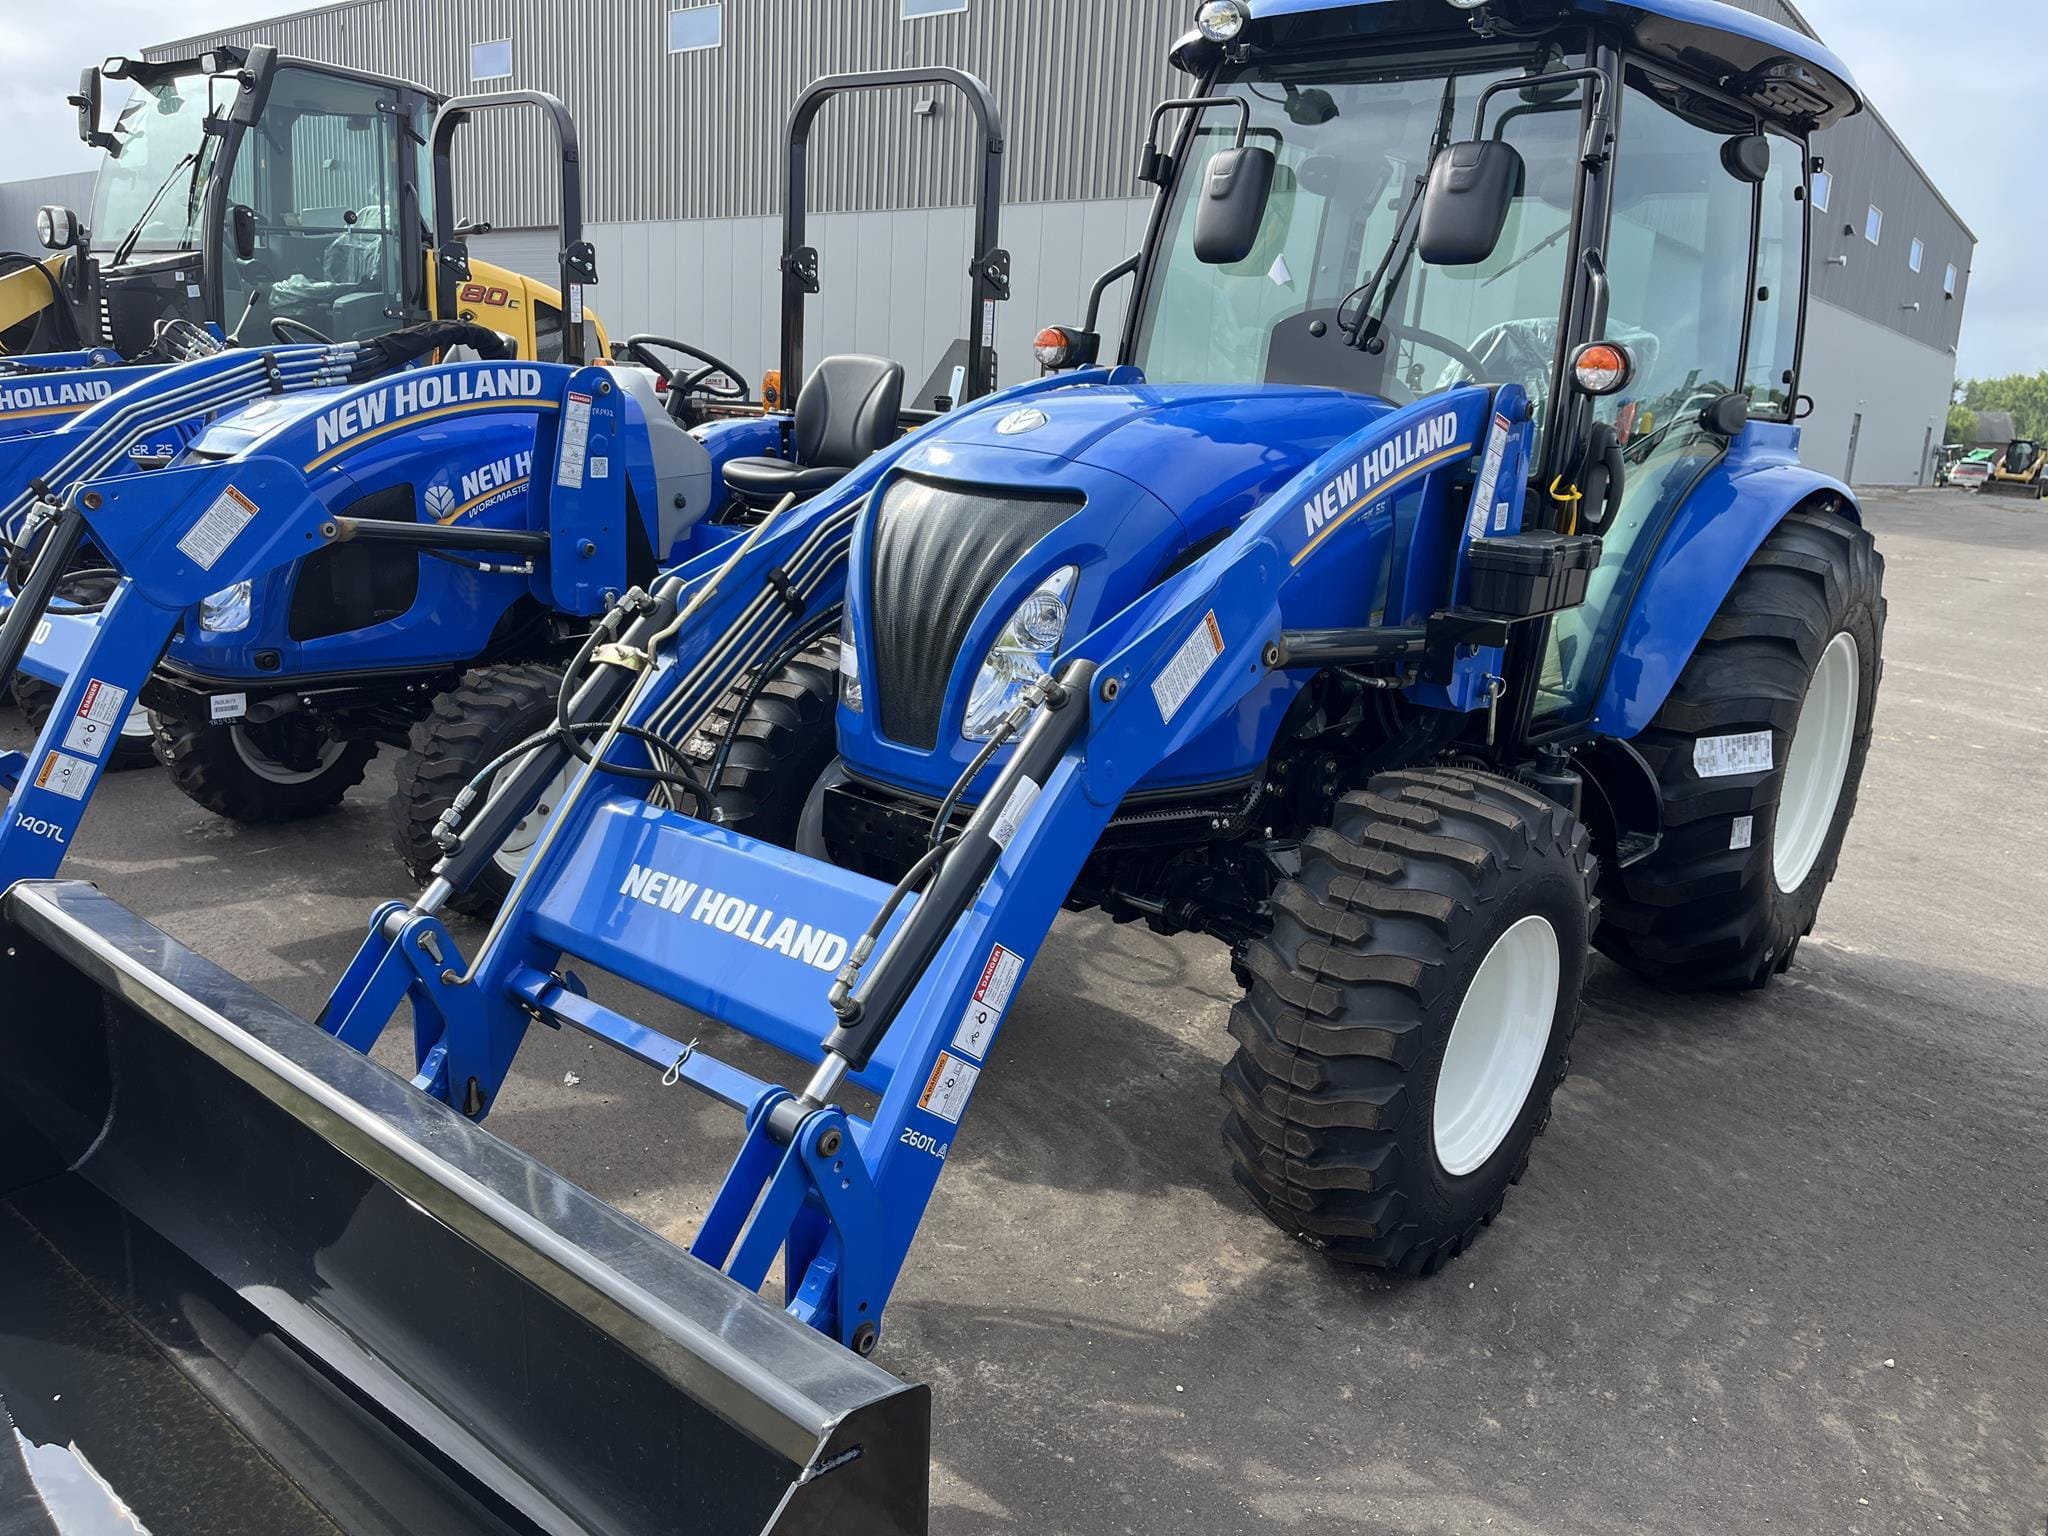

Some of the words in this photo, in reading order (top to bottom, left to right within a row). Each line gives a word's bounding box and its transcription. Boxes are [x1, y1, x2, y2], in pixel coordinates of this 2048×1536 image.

[0, 380, 113, 410] HOLLAND
[316, 388, 388, 453] NEW
[395, 368, 542, 417] HOLLAND
[156, 444, 174, 455] 25
[460, 455, 513, 501] NEW
[1303, 463, 1358, 537] NEW
[1363, 411, 1457, 490] HOLLAND
[82, 682, 100, 710] DANGER
[15, 812, 65, 844] 140TL
[619, 863, 698, 914] NEW
[690, 888, 849, 973] HOLLAND
[981, 949, 1002, 989] DANGER
[926, 1057, 947, 1093] WARNING
